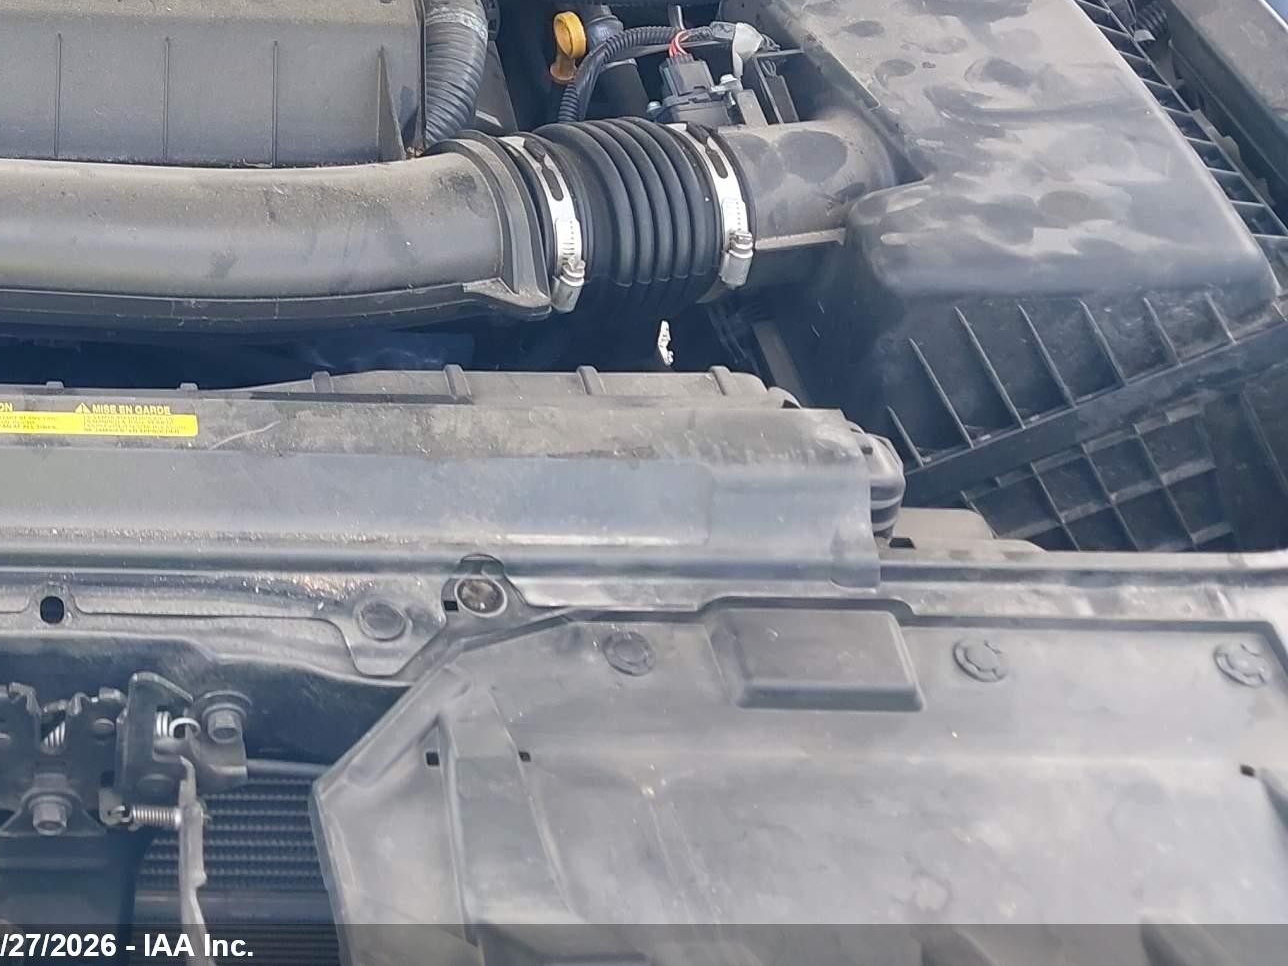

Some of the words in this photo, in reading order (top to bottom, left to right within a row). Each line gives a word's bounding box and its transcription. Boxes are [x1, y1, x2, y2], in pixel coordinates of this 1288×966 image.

[92, 404, 117, 415] MISE
[118, 405, 133, 415] EN
[134, 405, 171, 416] GARDE
